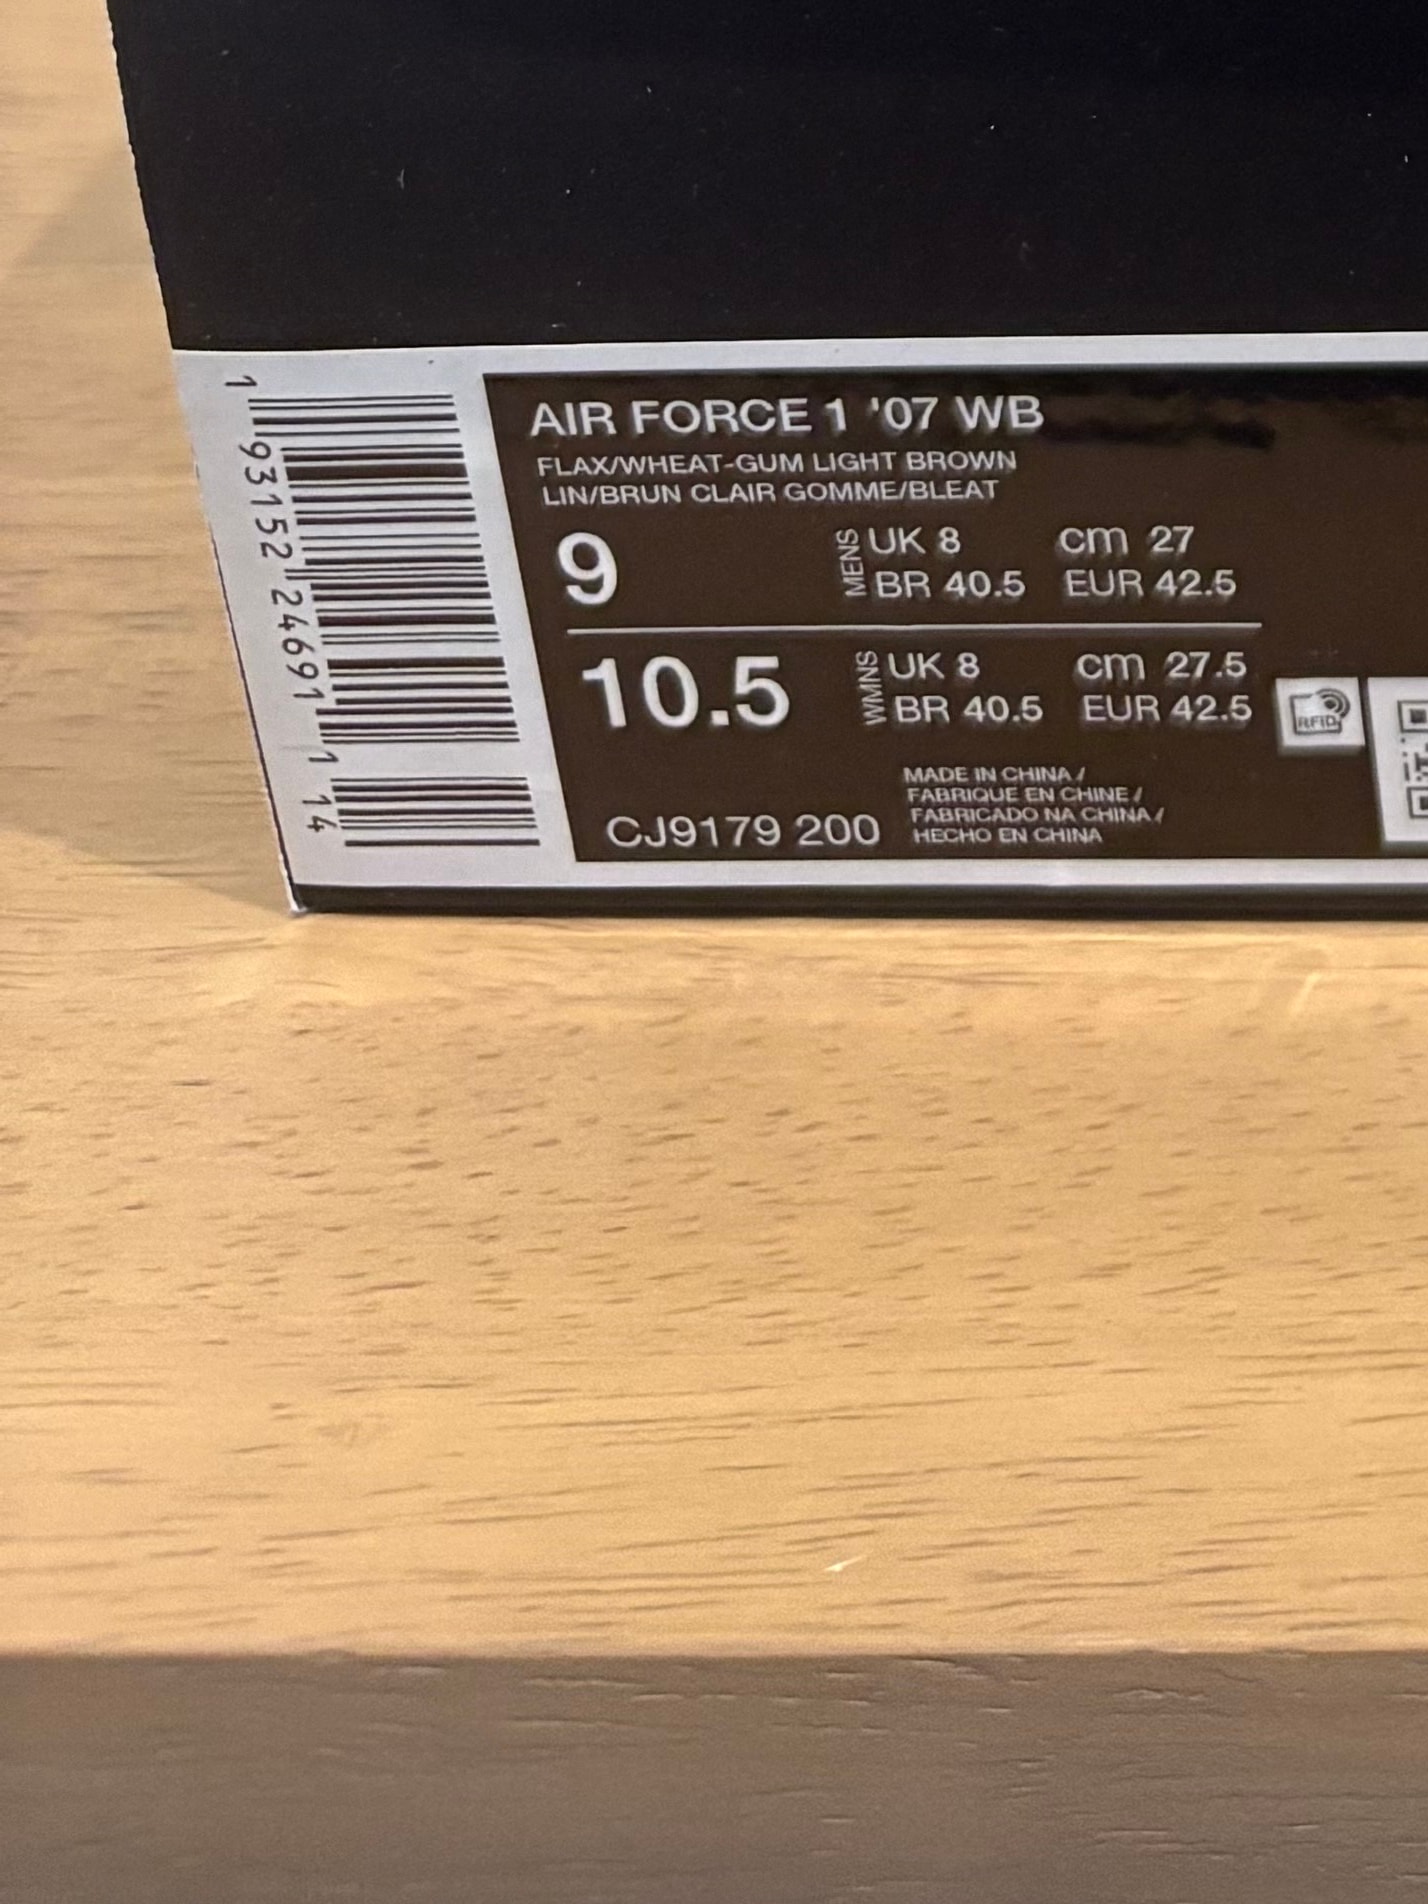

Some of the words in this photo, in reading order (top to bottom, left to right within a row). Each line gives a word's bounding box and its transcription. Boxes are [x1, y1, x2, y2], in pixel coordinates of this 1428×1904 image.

[530, 401, 617, 437] AIR
[631, 398, 812, 435] FORCE
[824, 397, 847, 432] 1
[868, 395, 939, 431] '07
[955, 394, 1045, 430] WB
[537, 452, 804, 477] FLAX/WHEAT-GUM
[813, 451, 897, 473] LIGHT
[906, 449, 1017, 471] BROWN
[543, 484, 682, 506] LIN/BRUN
[691, 482, 776, 503] CLAIR
[784, 478, 999, 502] GOMME/BLEAT
[868, 526, 927, 555] UK
[938, 525, 962, 554] 8
[1059, 526, 1129, 555] cm
[1149, 524, 1195, 554] 27
[557, 531, 618, 605] 9
[836, 528, 867, 597] MENS
[875, 570, 932, 599] BR
[945, 569, 1026, 598] 40.5
[1066, 568, 1144, 597] EUR
[1155, 568, 1237, 597] 42.5
[888, 651, 945, 679] UK
[957, 651, 981, 679] 8
[1076, 652, 1146, 681] cm
[1167, 650, 1247, 679] 27.5
[581, 655, 791, 728] 10.5
[855, 650, 887, 726] WMNS
[895, 694, 950, 723] BR
[963, 694, 1044, 723] 40.5
[1083, 694, 1161, 722] EUR
[1170, 694, 1252, 722] 42.5
[1298, 714, 1337, 729] RFID
[903, 766, 969, 783] MADE
[975, 766, 997, 782] IN
[1001, 766, 1072, 782] CHINA
[907, 787, 1019, 803] FABRIQUE
[1025, 786, 1055, 802] EN
[1060, 786, 1129, 802] CHINE
[911, 807, 1039, 823] FABRICADO
[1044, 807, 1076, 822] NA
[1080, 806, 1151, 822] CHINA
[606, 814, 781, 848] CJ9179
[795, 813, 881, 846] 200
[914, 827, 992, 844] HECHO
[998, 827, 1028, 843] EN
[1033, 827, 1103, 843] CHINA
